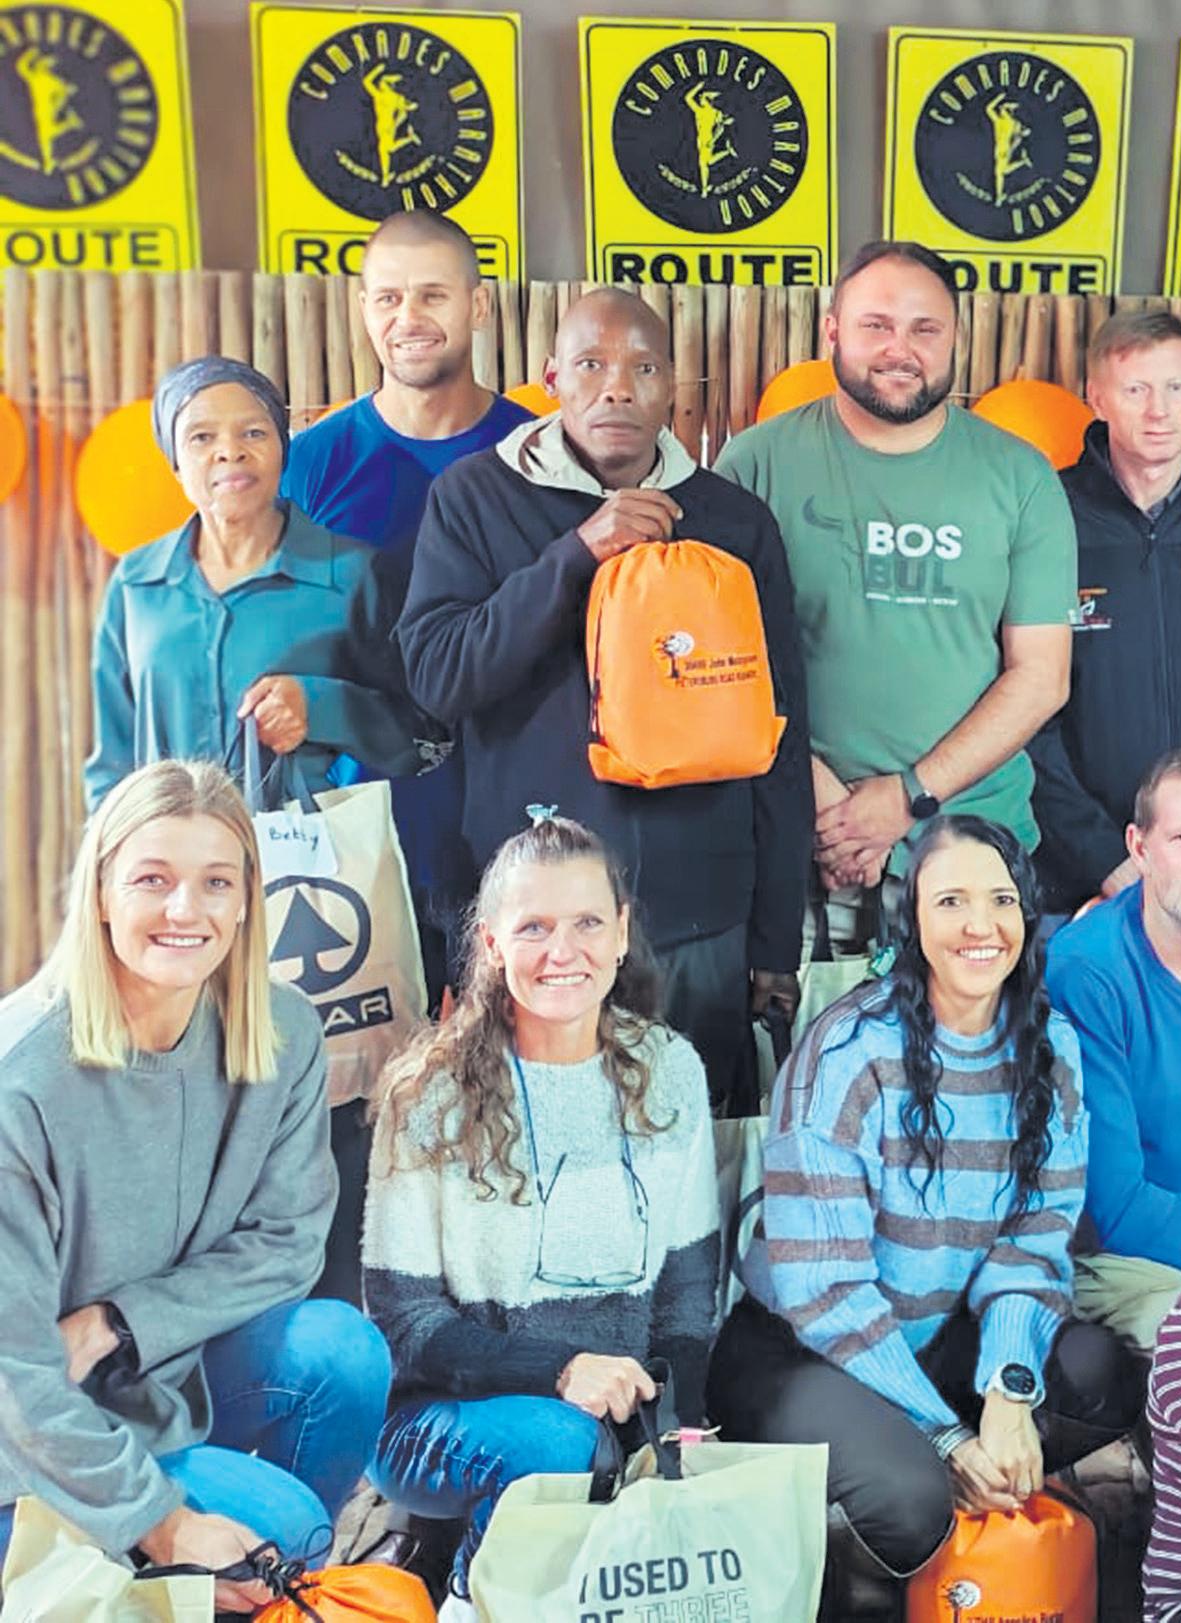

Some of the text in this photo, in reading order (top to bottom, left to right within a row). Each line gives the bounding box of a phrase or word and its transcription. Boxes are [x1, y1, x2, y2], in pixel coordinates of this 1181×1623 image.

[301, 29, 487, 212] COMRADES MARATHON
[625, 48, 800, 225] COMRADES MARATHON
[929, 59, 1093, 234] COMRADES MARATHON
[5, 230, 161, 267] OUTE
[294, 238, 497, 279] ROE
[612, 252, 813, 285] ROUTE
[948, 260, 1098, 294] OUTE
[867, 521, 962, 560] BOS
[324, 996, 389, 1031] AR
[599, 1556, 689, 1601] USED
[698, 1549, 742, 1584] TO
